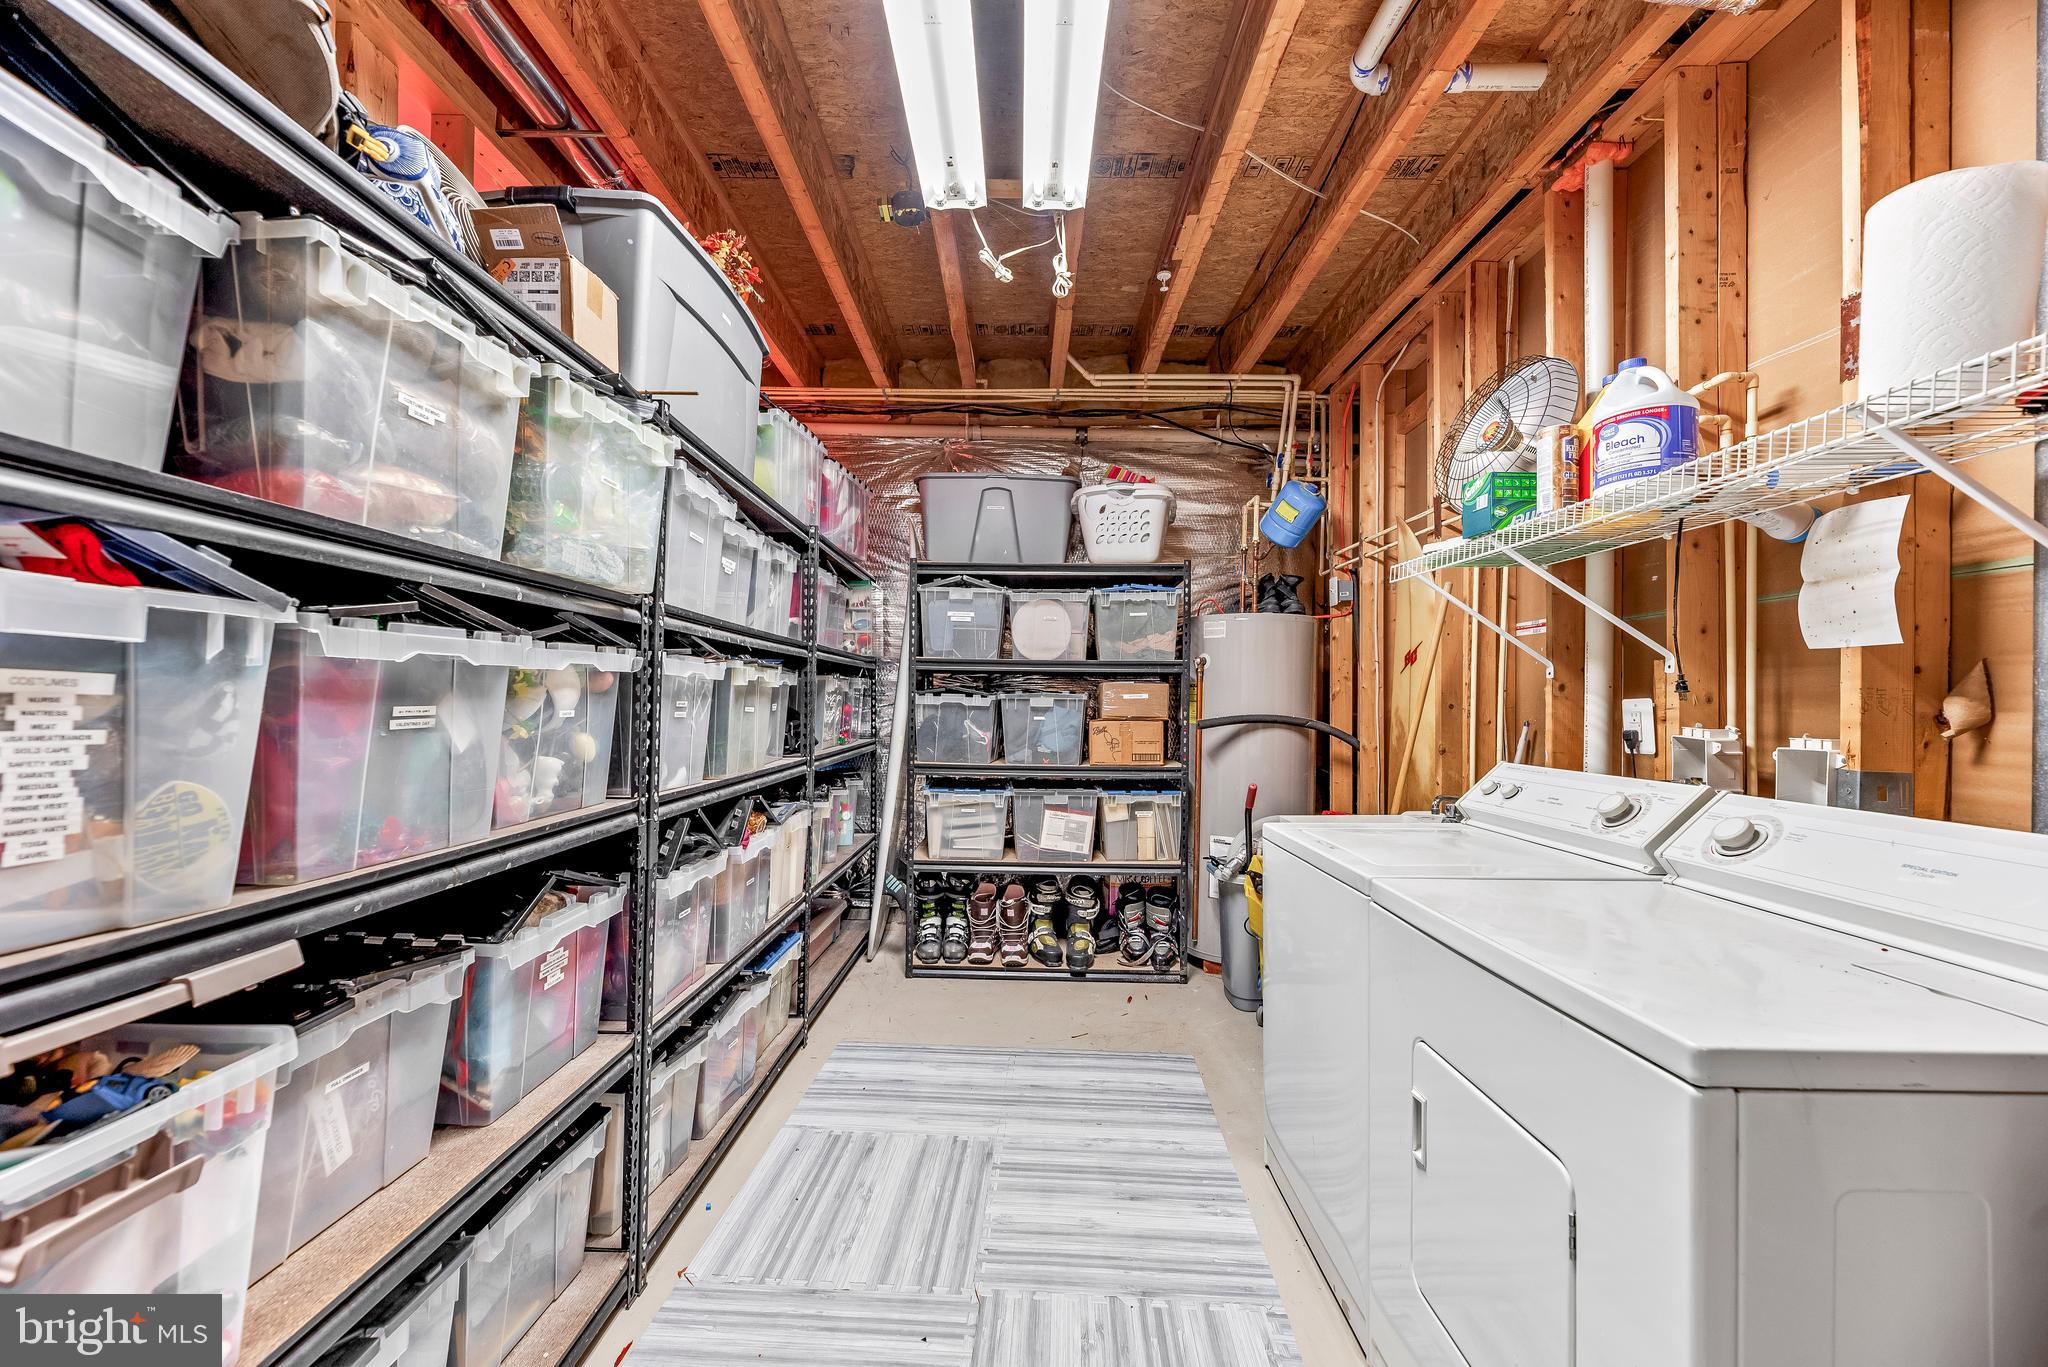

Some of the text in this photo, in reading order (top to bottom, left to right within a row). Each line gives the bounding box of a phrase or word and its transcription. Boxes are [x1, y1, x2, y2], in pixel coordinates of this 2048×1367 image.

[1616, 410, 1641, 420] BRIGHTER
[1605, 434, 1645, 451] Bleach
[8, 676, 79, 688] COSTUMES
[1902, 864, 1958, 877] SPECIAL EDITION
